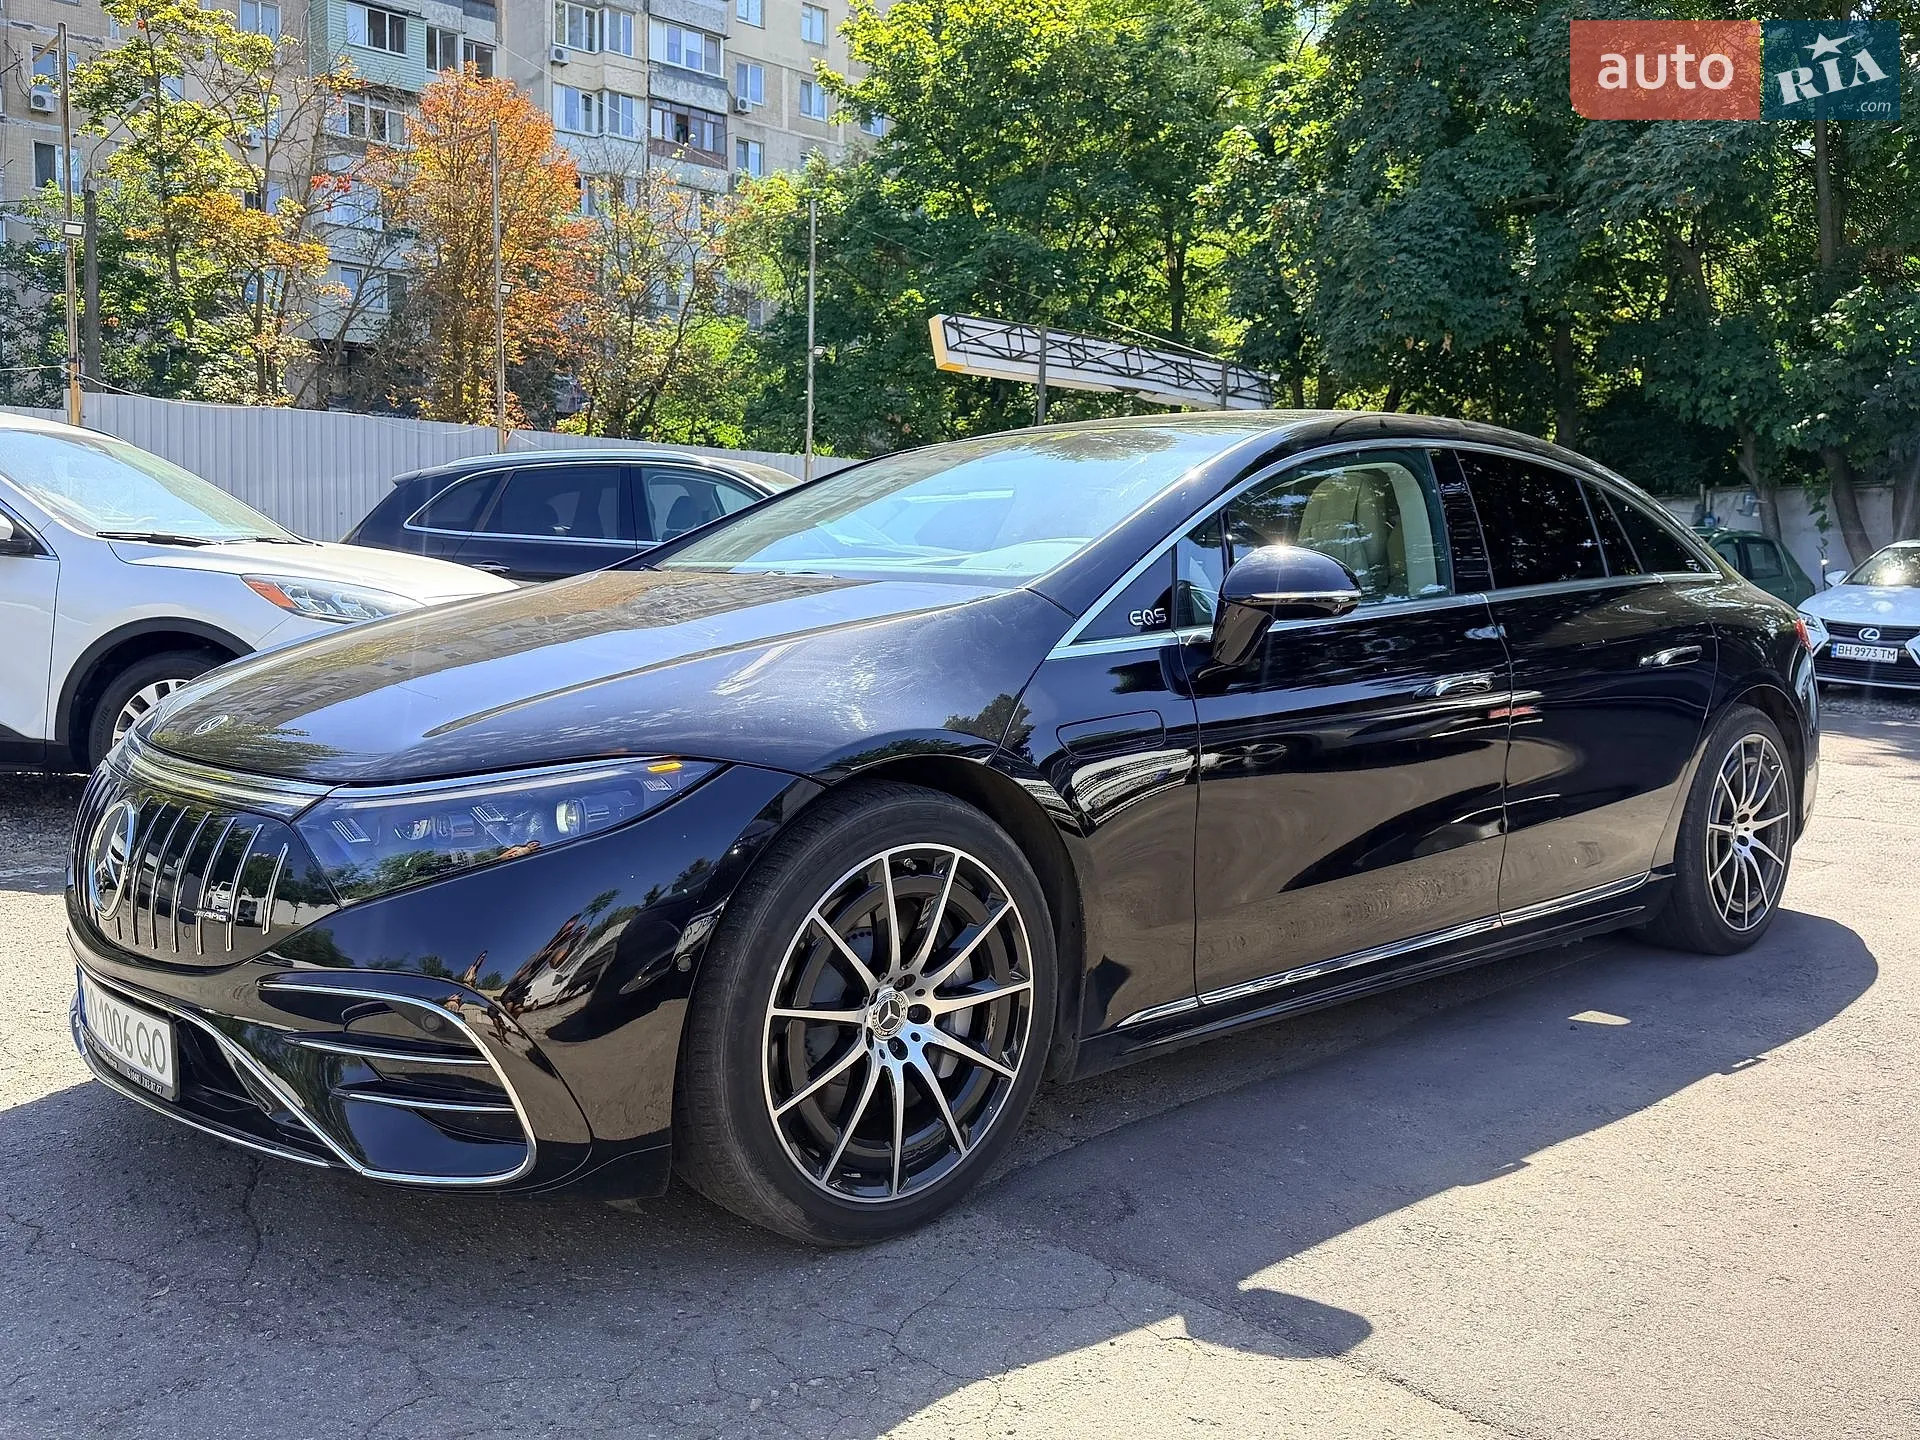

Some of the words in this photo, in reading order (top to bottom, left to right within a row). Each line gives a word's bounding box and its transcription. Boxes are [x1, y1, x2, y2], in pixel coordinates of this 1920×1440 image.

[1129, 607, 1167, 626] EQS
[1838, 646, 1853, 656] BH
[1854, 647, 1878, 658] 9973
[1880, 650, 1896, 660] TM
[99, 998, 133, 1059] 1006
